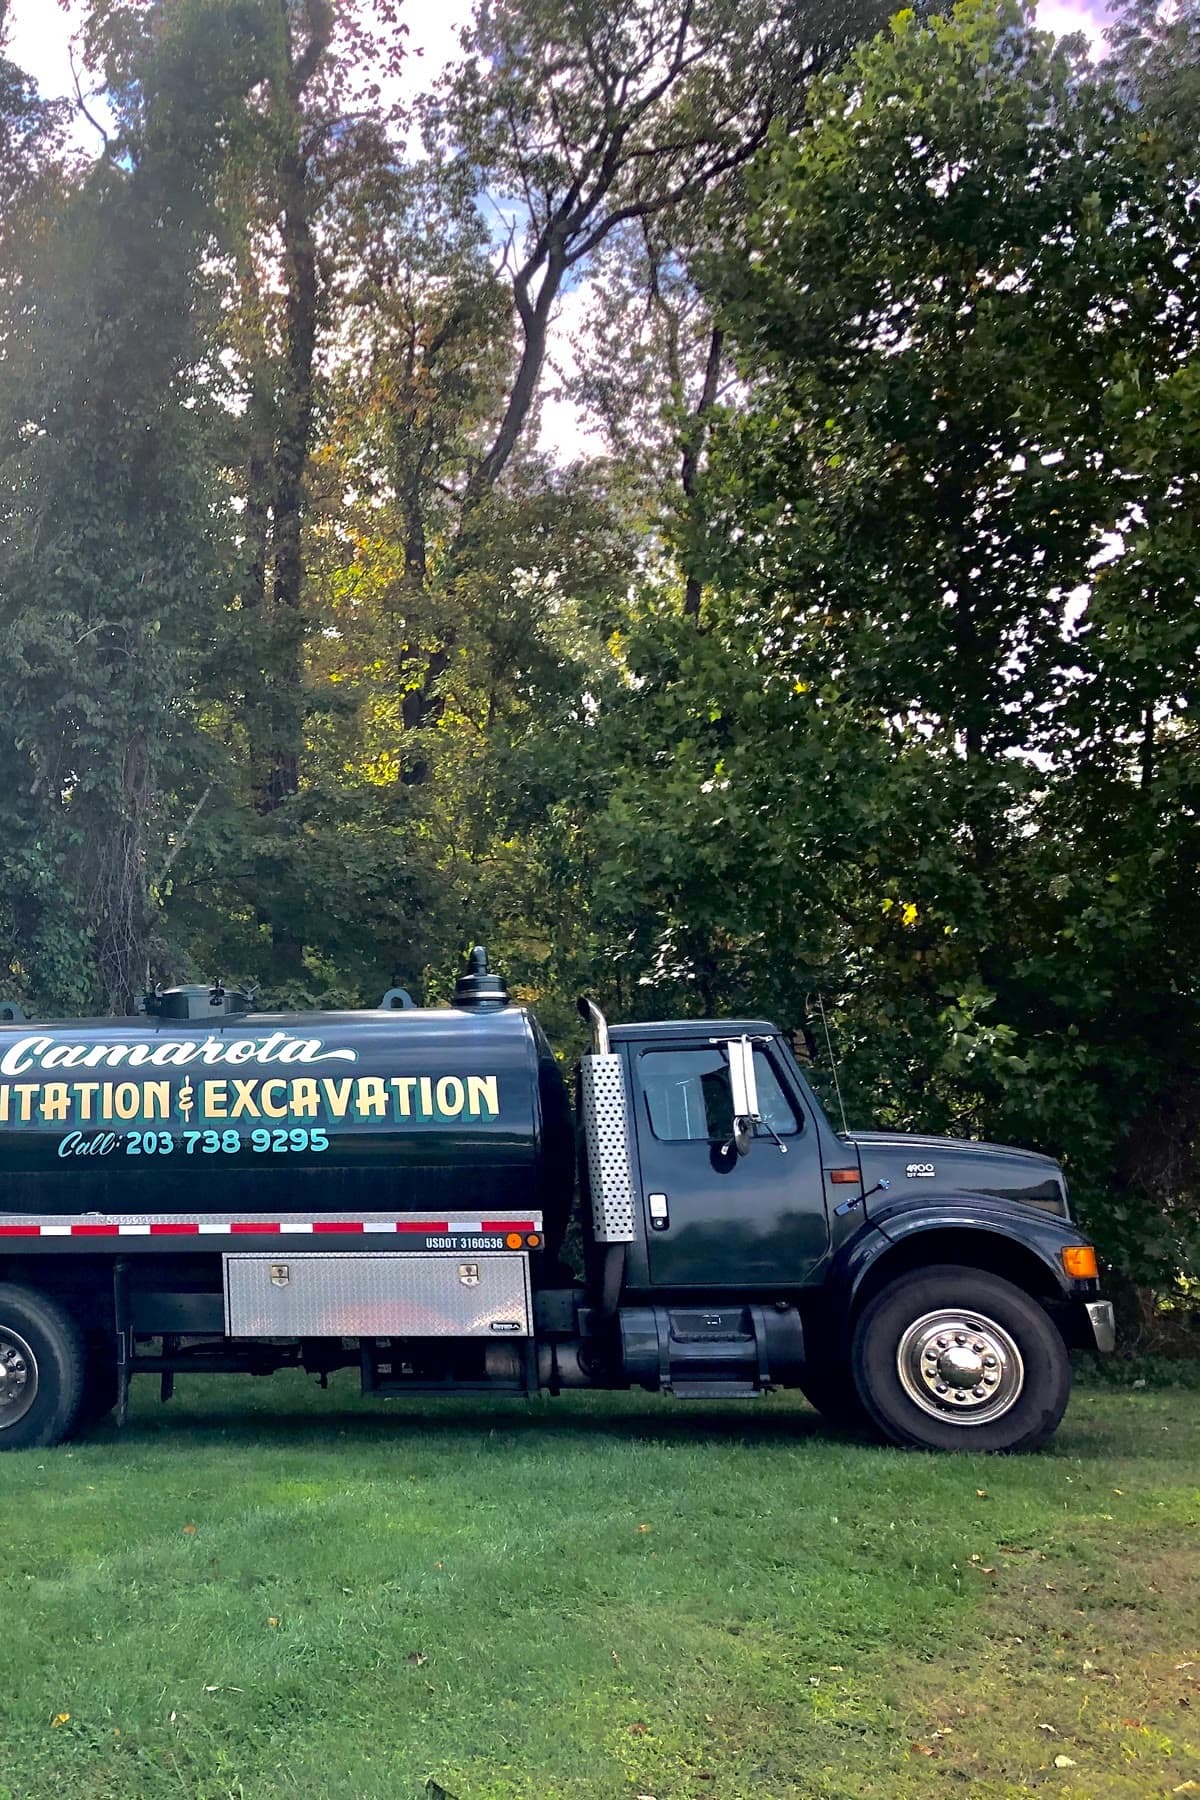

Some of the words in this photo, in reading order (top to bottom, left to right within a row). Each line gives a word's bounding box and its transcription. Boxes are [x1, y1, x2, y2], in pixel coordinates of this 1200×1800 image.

[0, 1031, 358, 1076] Camarota
[178, 1075, 194, 1123] &
[203, 1075, 501, 1119] EXCAVATION
[57, 1130, 124, 1158] Call:
[125, 1131, 175, 1155] 203
[182, 1129, 241, 1154] 738
[251, 1128, 330, 1153] 9295
[906, 1163, 934, 1173] 4900
[425, 1237, 458, 1249] USDOT
[460, 1237, 504, 1249] 3160536
